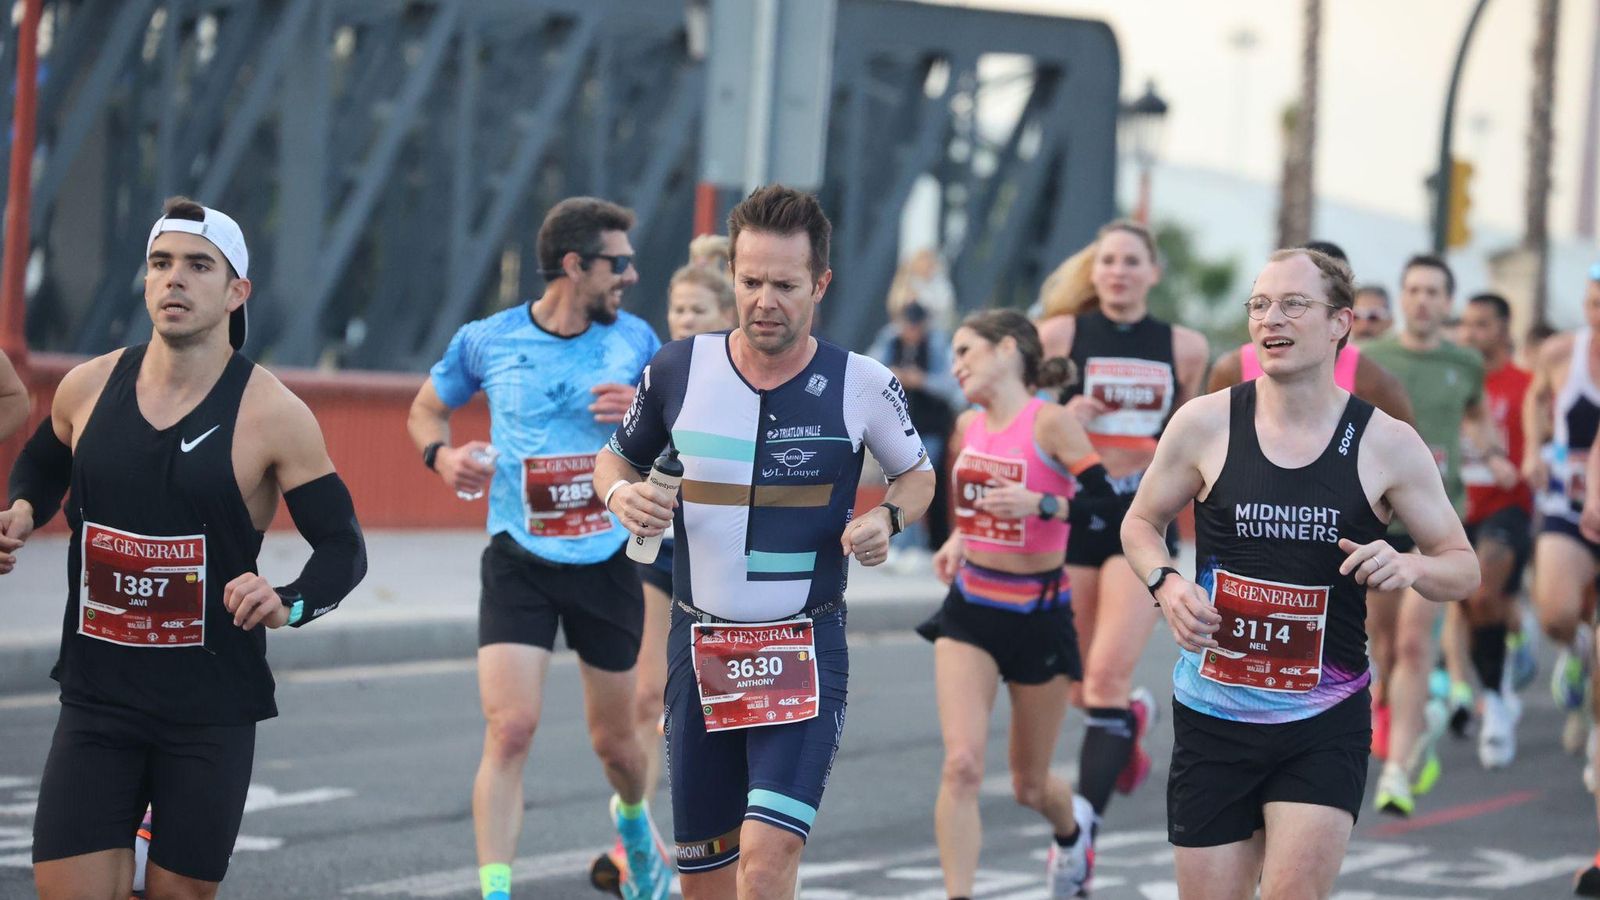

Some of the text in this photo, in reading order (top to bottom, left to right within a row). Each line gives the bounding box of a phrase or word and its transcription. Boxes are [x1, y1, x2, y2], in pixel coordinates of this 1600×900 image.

[625, 392, 645, 438] REPUBLIC
[881, 389, 907, 427] REPUBLIC
[779, 425, 821, 438] TRIATLON HALLE
[1338, 423, 1356, 456] soar
[546, 457, 596, 473] GENERA
[787, 468, 820, 479] Louyet
[548, 482, 594, 502] 1285
[1235, 503, 1341, 526] MIDNIGHT
[1236, 522, 1339, 544] RUNNERS
[114, 537, 196, 559] GENERALI
[113, 571, 169, 598] 1387
[128, 598, 148, 607] JAVI
[1238, 583, 1319, 608] GENERALI
[161, 620, 185, 628] 42K
[1232, 617, 1290, 644] 3114
[727, 627, 805, 645] GENERALI
[1249, 642, 1269, 652] NEIL
[726, 656, 783, 680] 3630
[1279, 667, 1302, 676] 42K
[736, 678, 775, 688] ANTHONY
[777, 697, 801, 706] 42K
